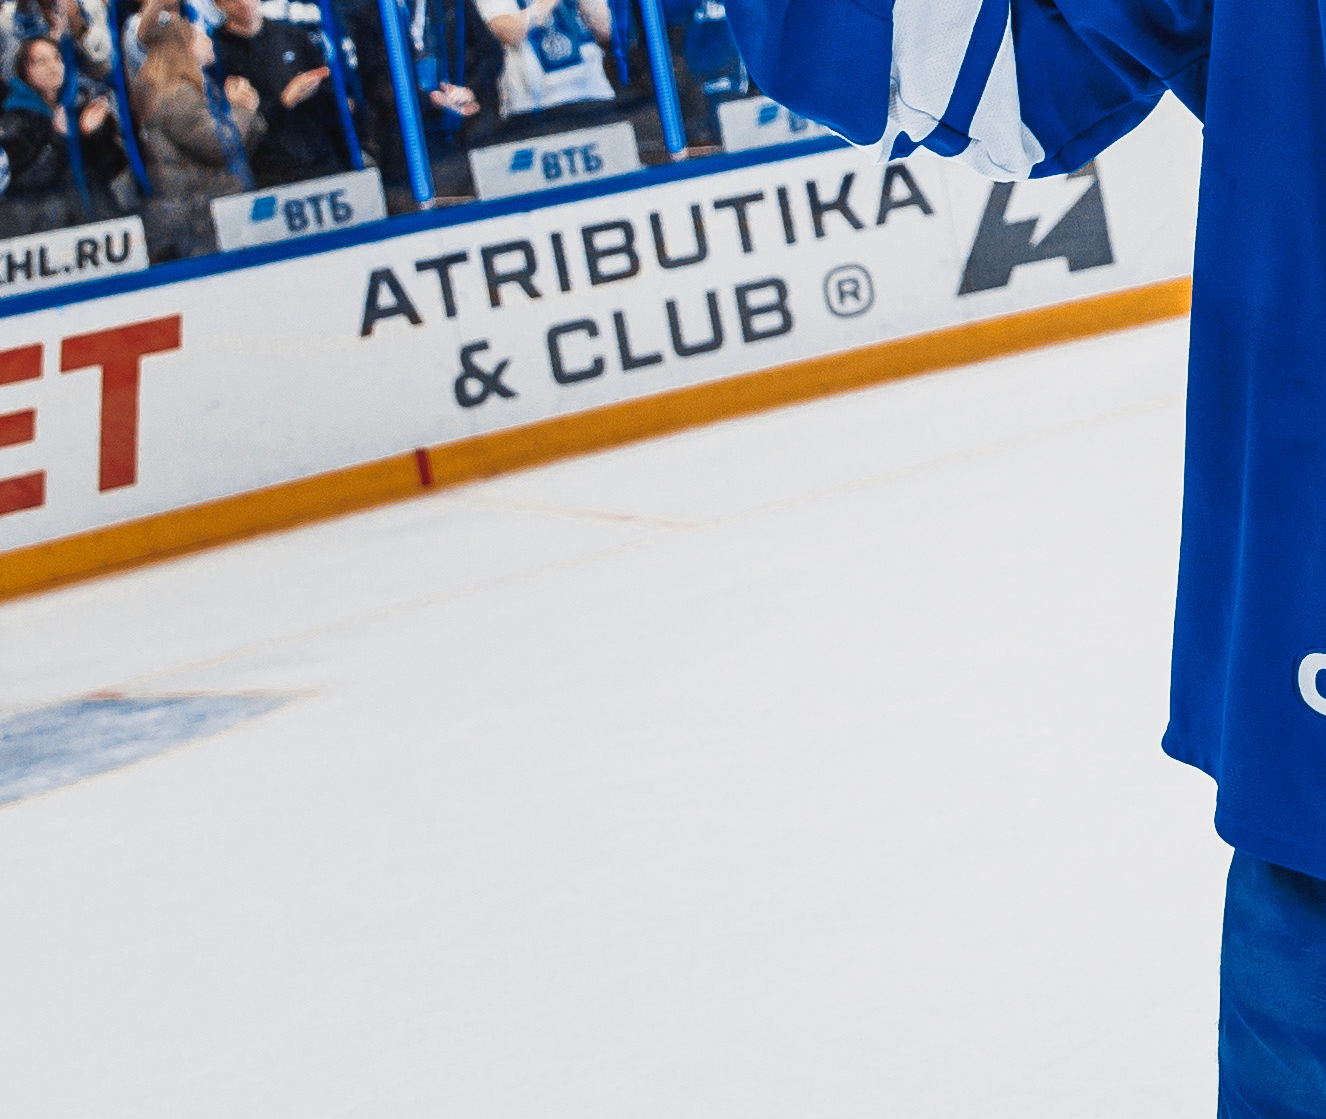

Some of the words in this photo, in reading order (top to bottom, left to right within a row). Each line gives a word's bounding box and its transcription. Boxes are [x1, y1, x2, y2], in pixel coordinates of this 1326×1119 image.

[540, 142, 604, 182] ВТБ
[285, 189, 353, 234] ВТБ
[0, 231, 131, 283] HL.RU
[359, 163, 934, 339] ATRIBUTIKA
[453, 341, 518, 409] &
[546, 276, 796, 387] CLUB
